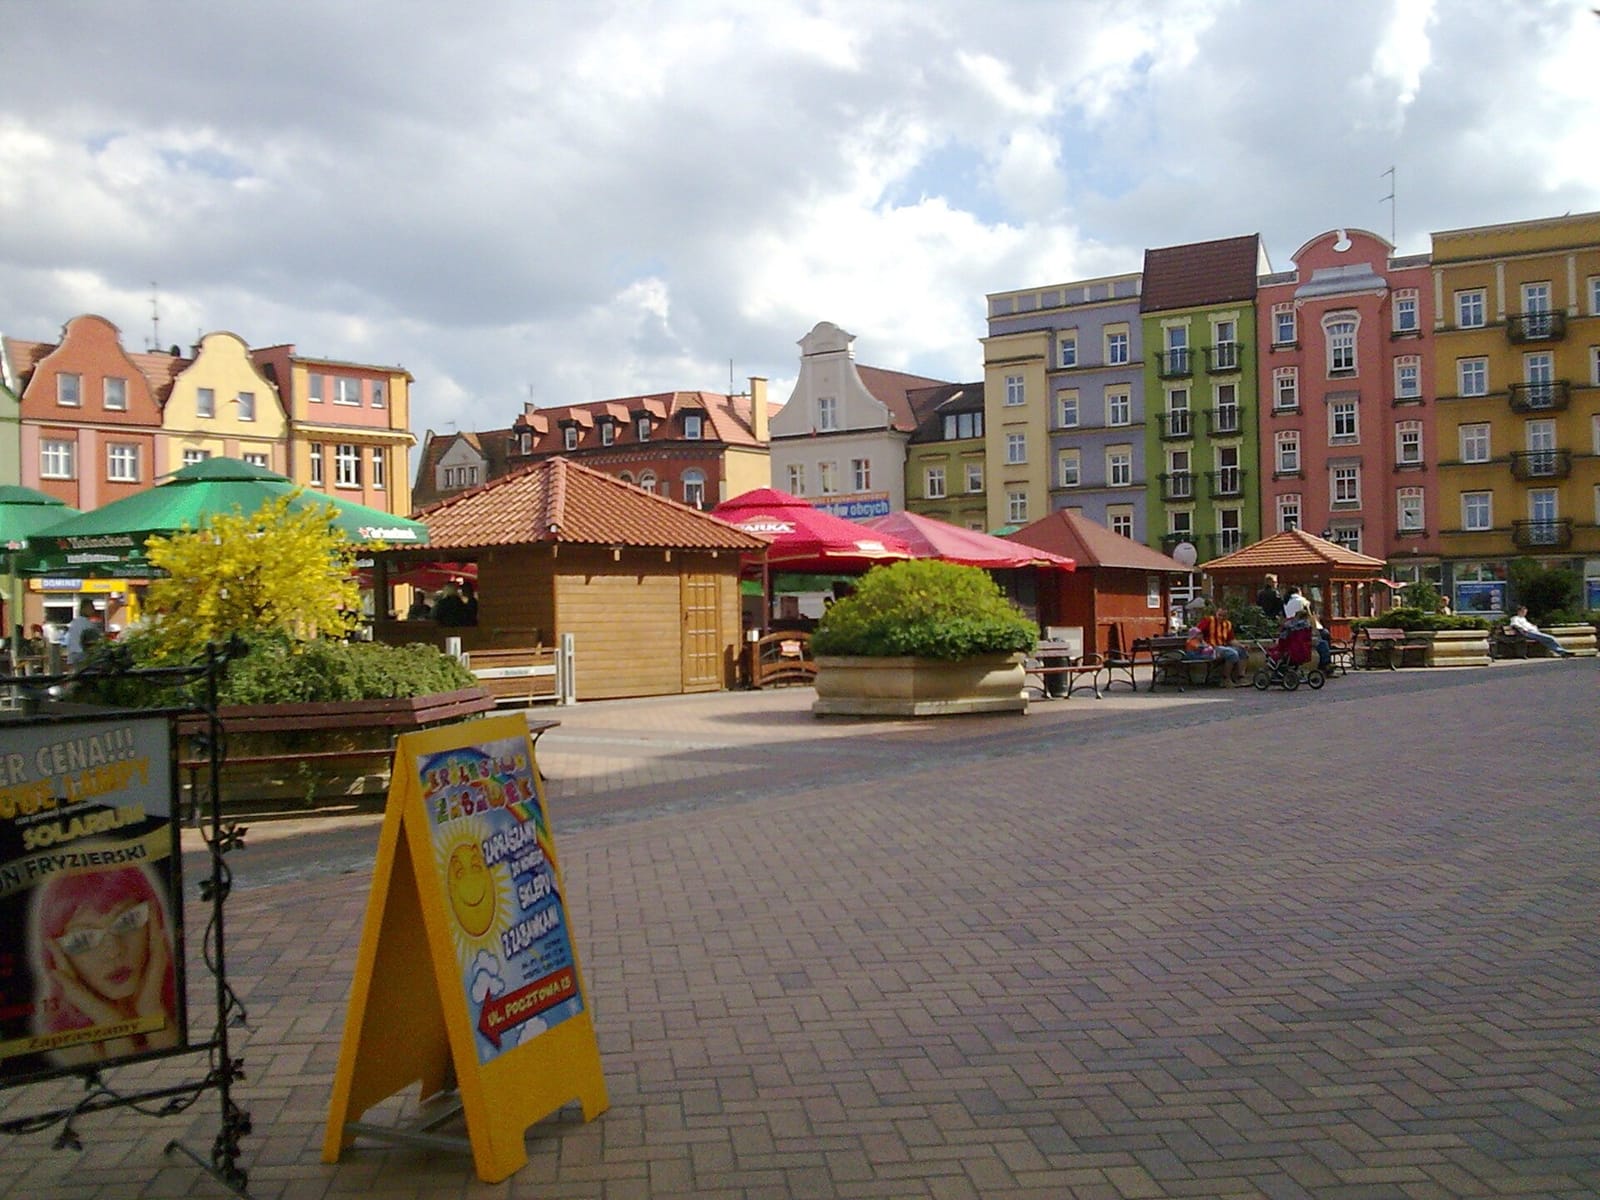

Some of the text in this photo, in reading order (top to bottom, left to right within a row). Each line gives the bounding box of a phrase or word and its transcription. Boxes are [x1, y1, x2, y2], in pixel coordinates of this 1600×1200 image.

[850, 501, 888, 517] obcych
[36, 727, 135, 776] CENA!!!
[63, 756, 148, 803] LAMPY
[433, 776, 534, 824] ZABAWEK
[22, 803, 146, 850] SOLARIUM
[24, 844, 147, 878] FRYZIERSKI
[505, 981, 560, 1018] POCZTOWA
